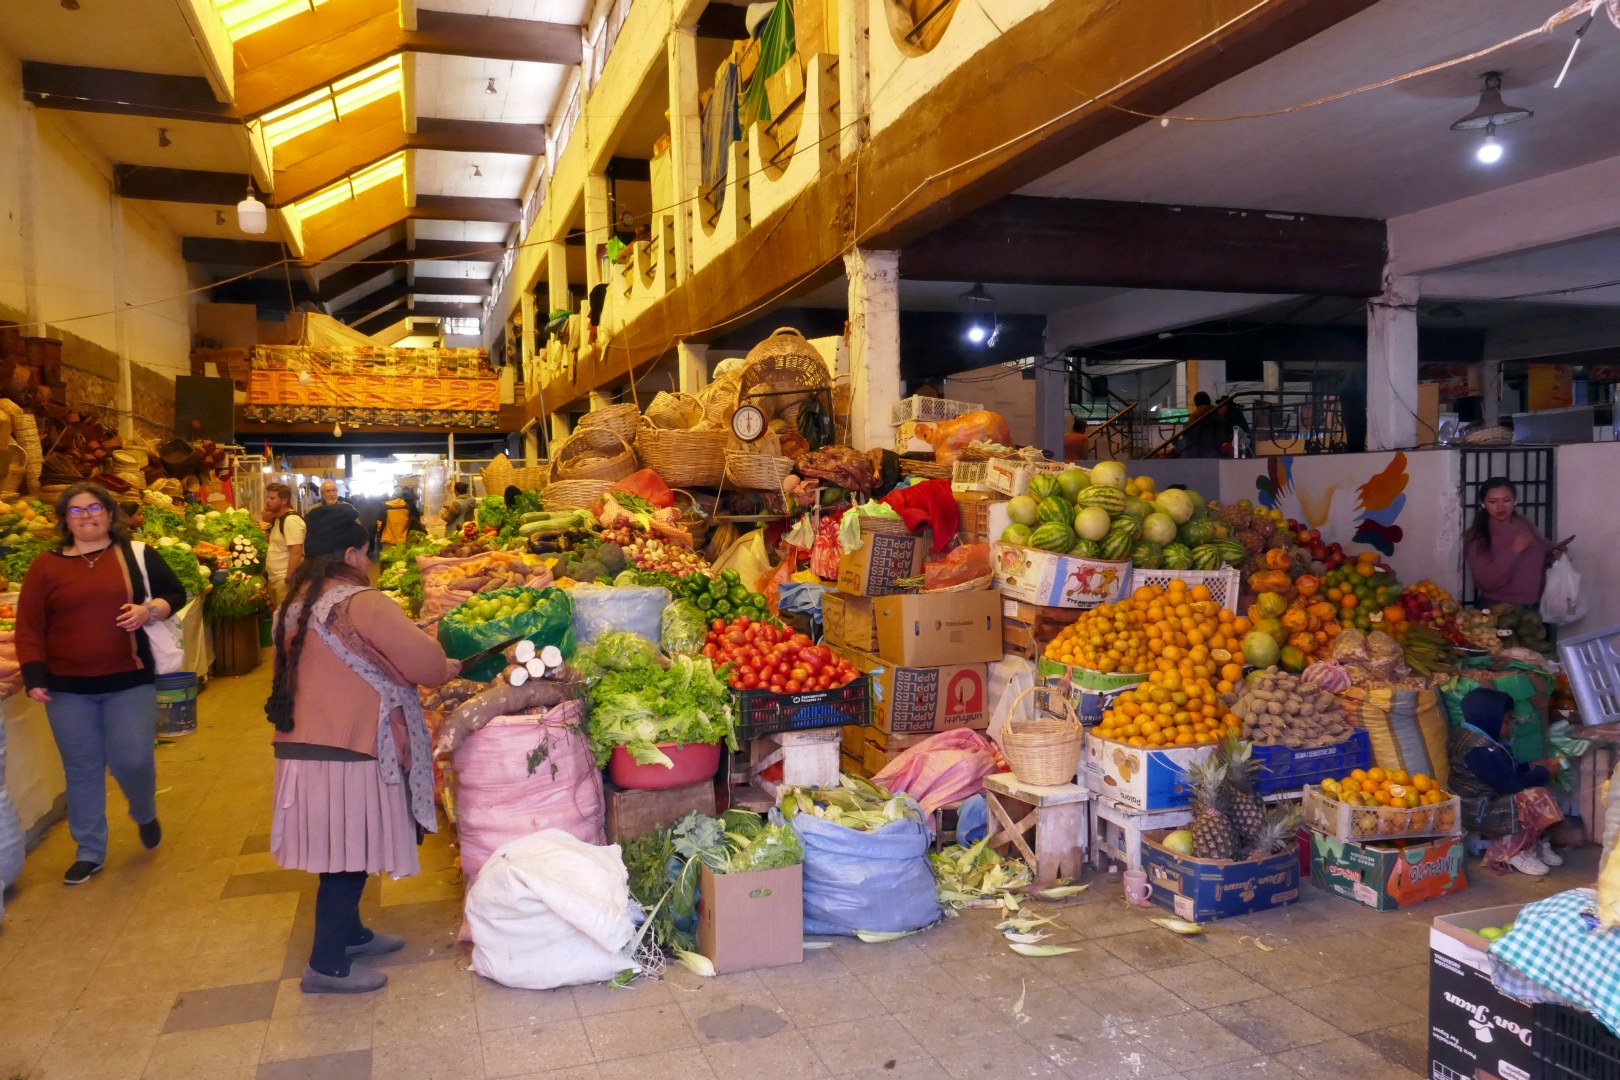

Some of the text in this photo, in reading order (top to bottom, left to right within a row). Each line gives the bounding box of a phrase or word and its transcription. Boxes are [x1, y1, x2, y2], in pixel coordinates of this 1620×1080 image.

[875, 536, 914, 549] APPLES
[873, 546, 913, 558] APPLES
[897, 671, 937, 682] APPLES
[896, 681, 937, 692] APPLES
[895, 701, 935, 711] APPLES
[894, 711, 935, 721] APPLES
[944, 713, 983, 724] unifrutti
[893, 721, 933, 731] APPLES
[1443, 991, 1490, 1023] Juan
